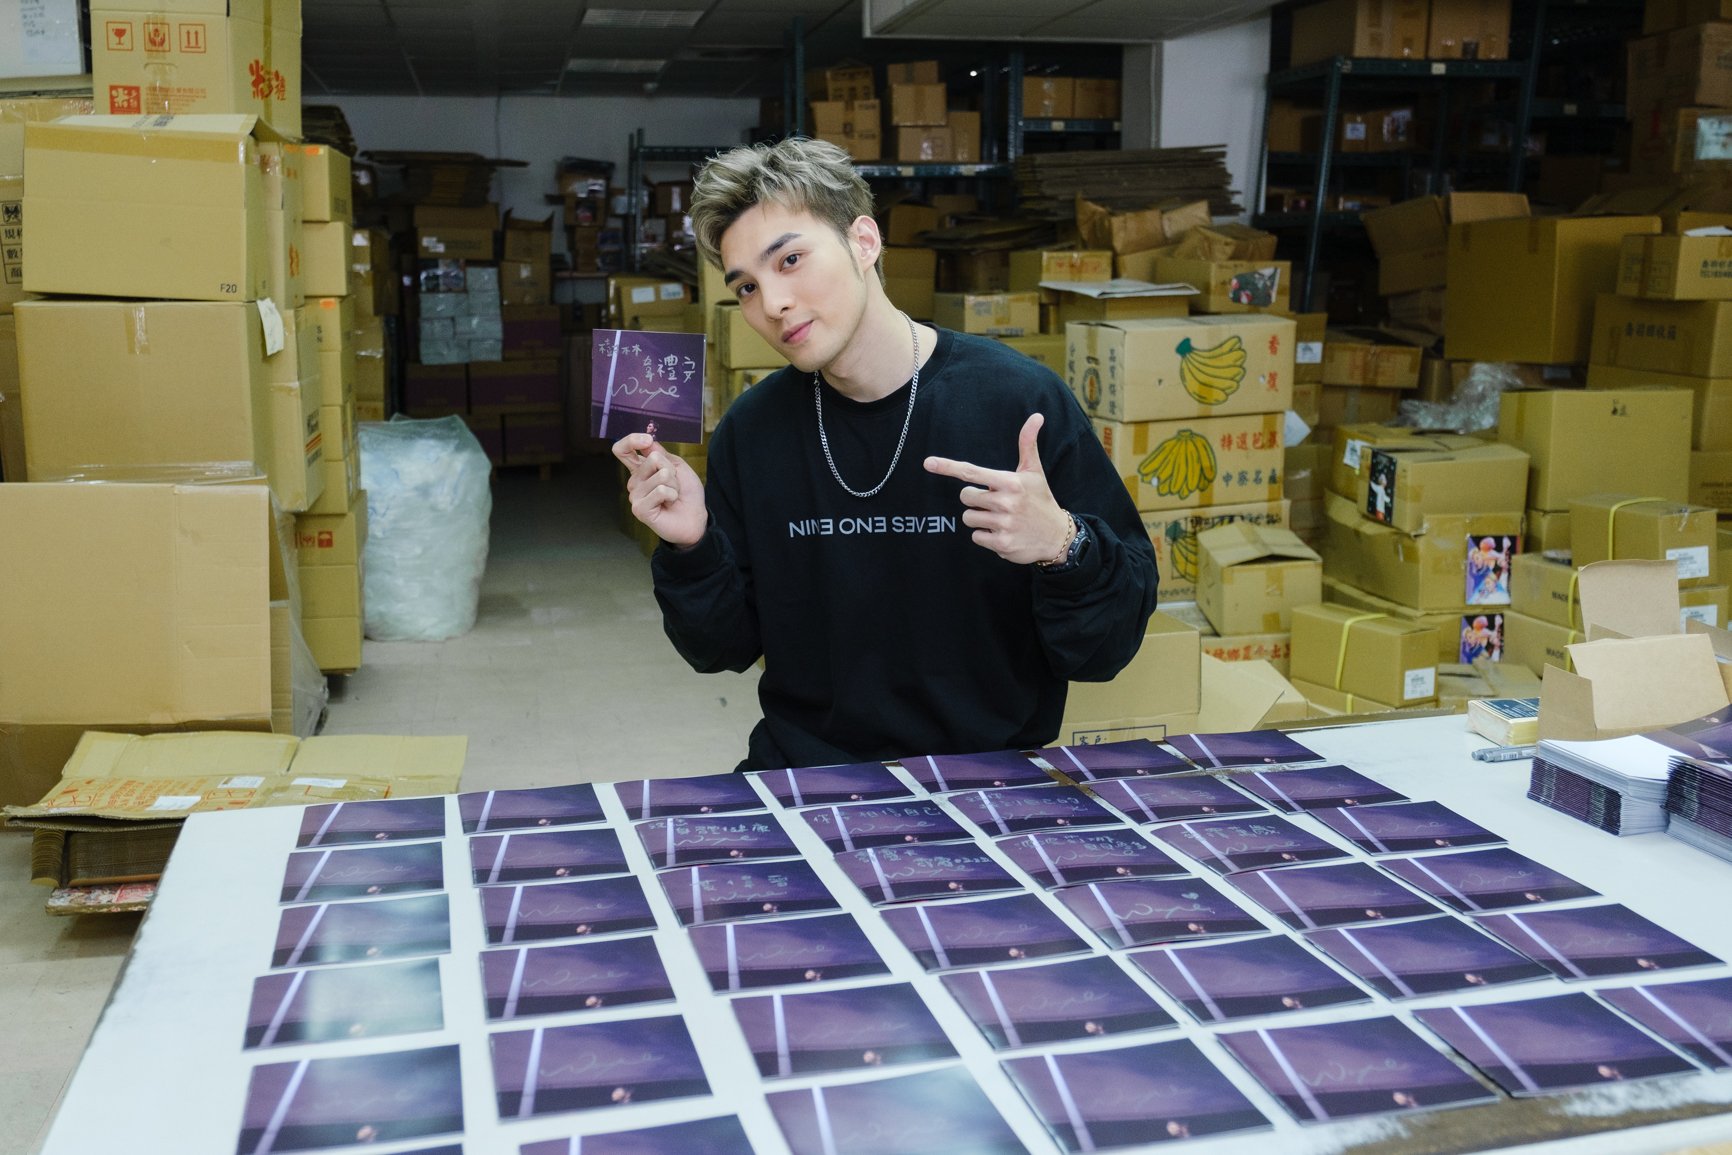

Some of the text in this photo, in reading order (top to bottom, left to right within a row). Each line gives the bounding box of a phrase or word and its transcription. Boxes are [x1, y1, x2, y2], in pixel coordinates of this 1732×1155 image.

[220, 283, 238, 294] F20
[839, 516, 887, 535] ONE
[891, 516, 956, 534] SEVEN
